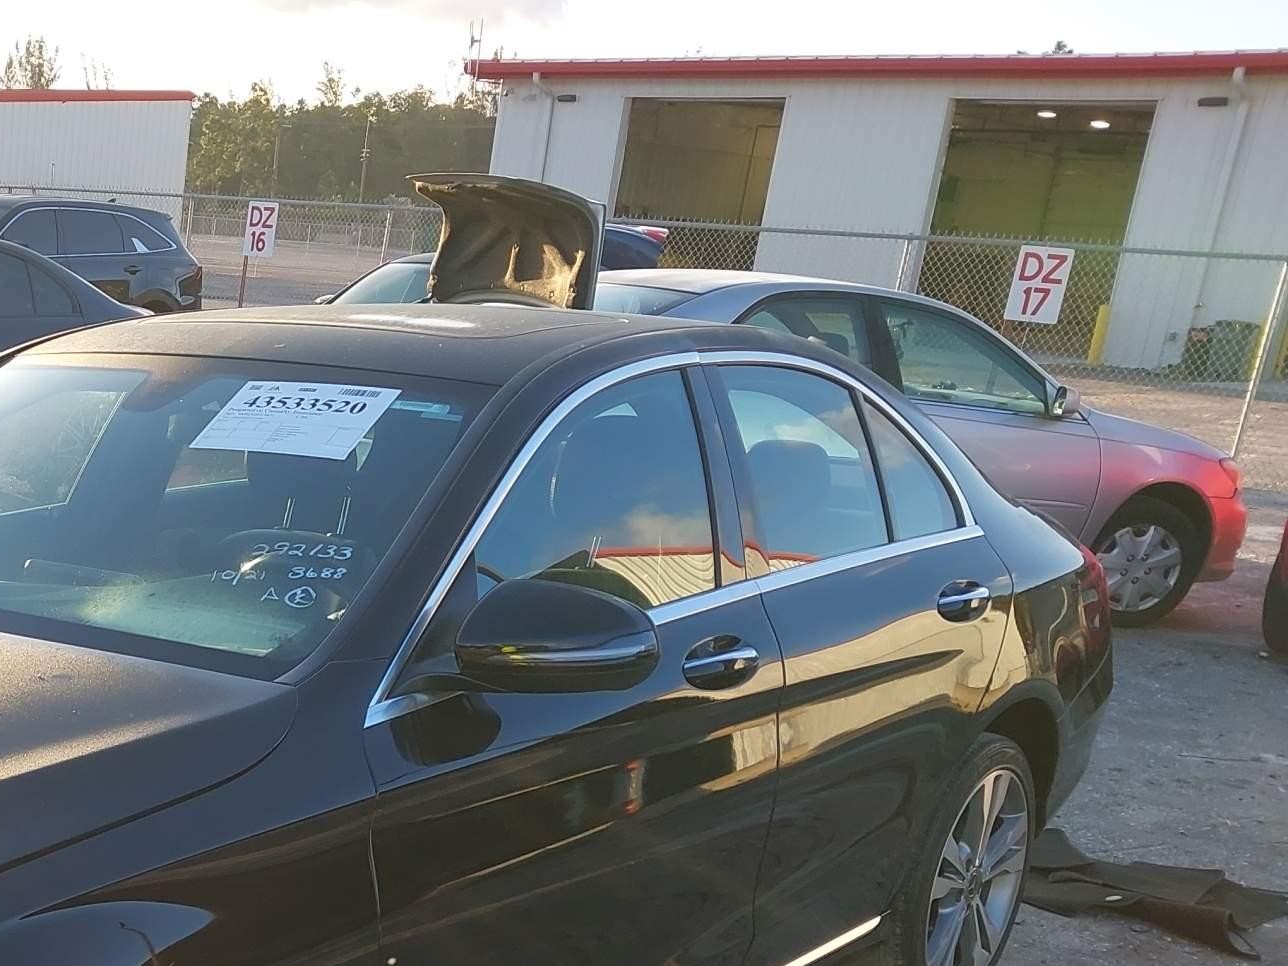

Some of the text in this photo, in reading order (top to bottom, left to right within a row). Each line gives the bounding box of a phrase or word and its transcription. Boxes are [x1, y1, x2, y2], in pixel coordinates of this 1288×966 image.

[249, 206, 275, 228] DZ
[250, 231, 266, 252] 16
[1018, 252, 1068, 284] DZ
[1021, 287, 1051, 316] 17
[242, 395, 367, 415] 43533520
